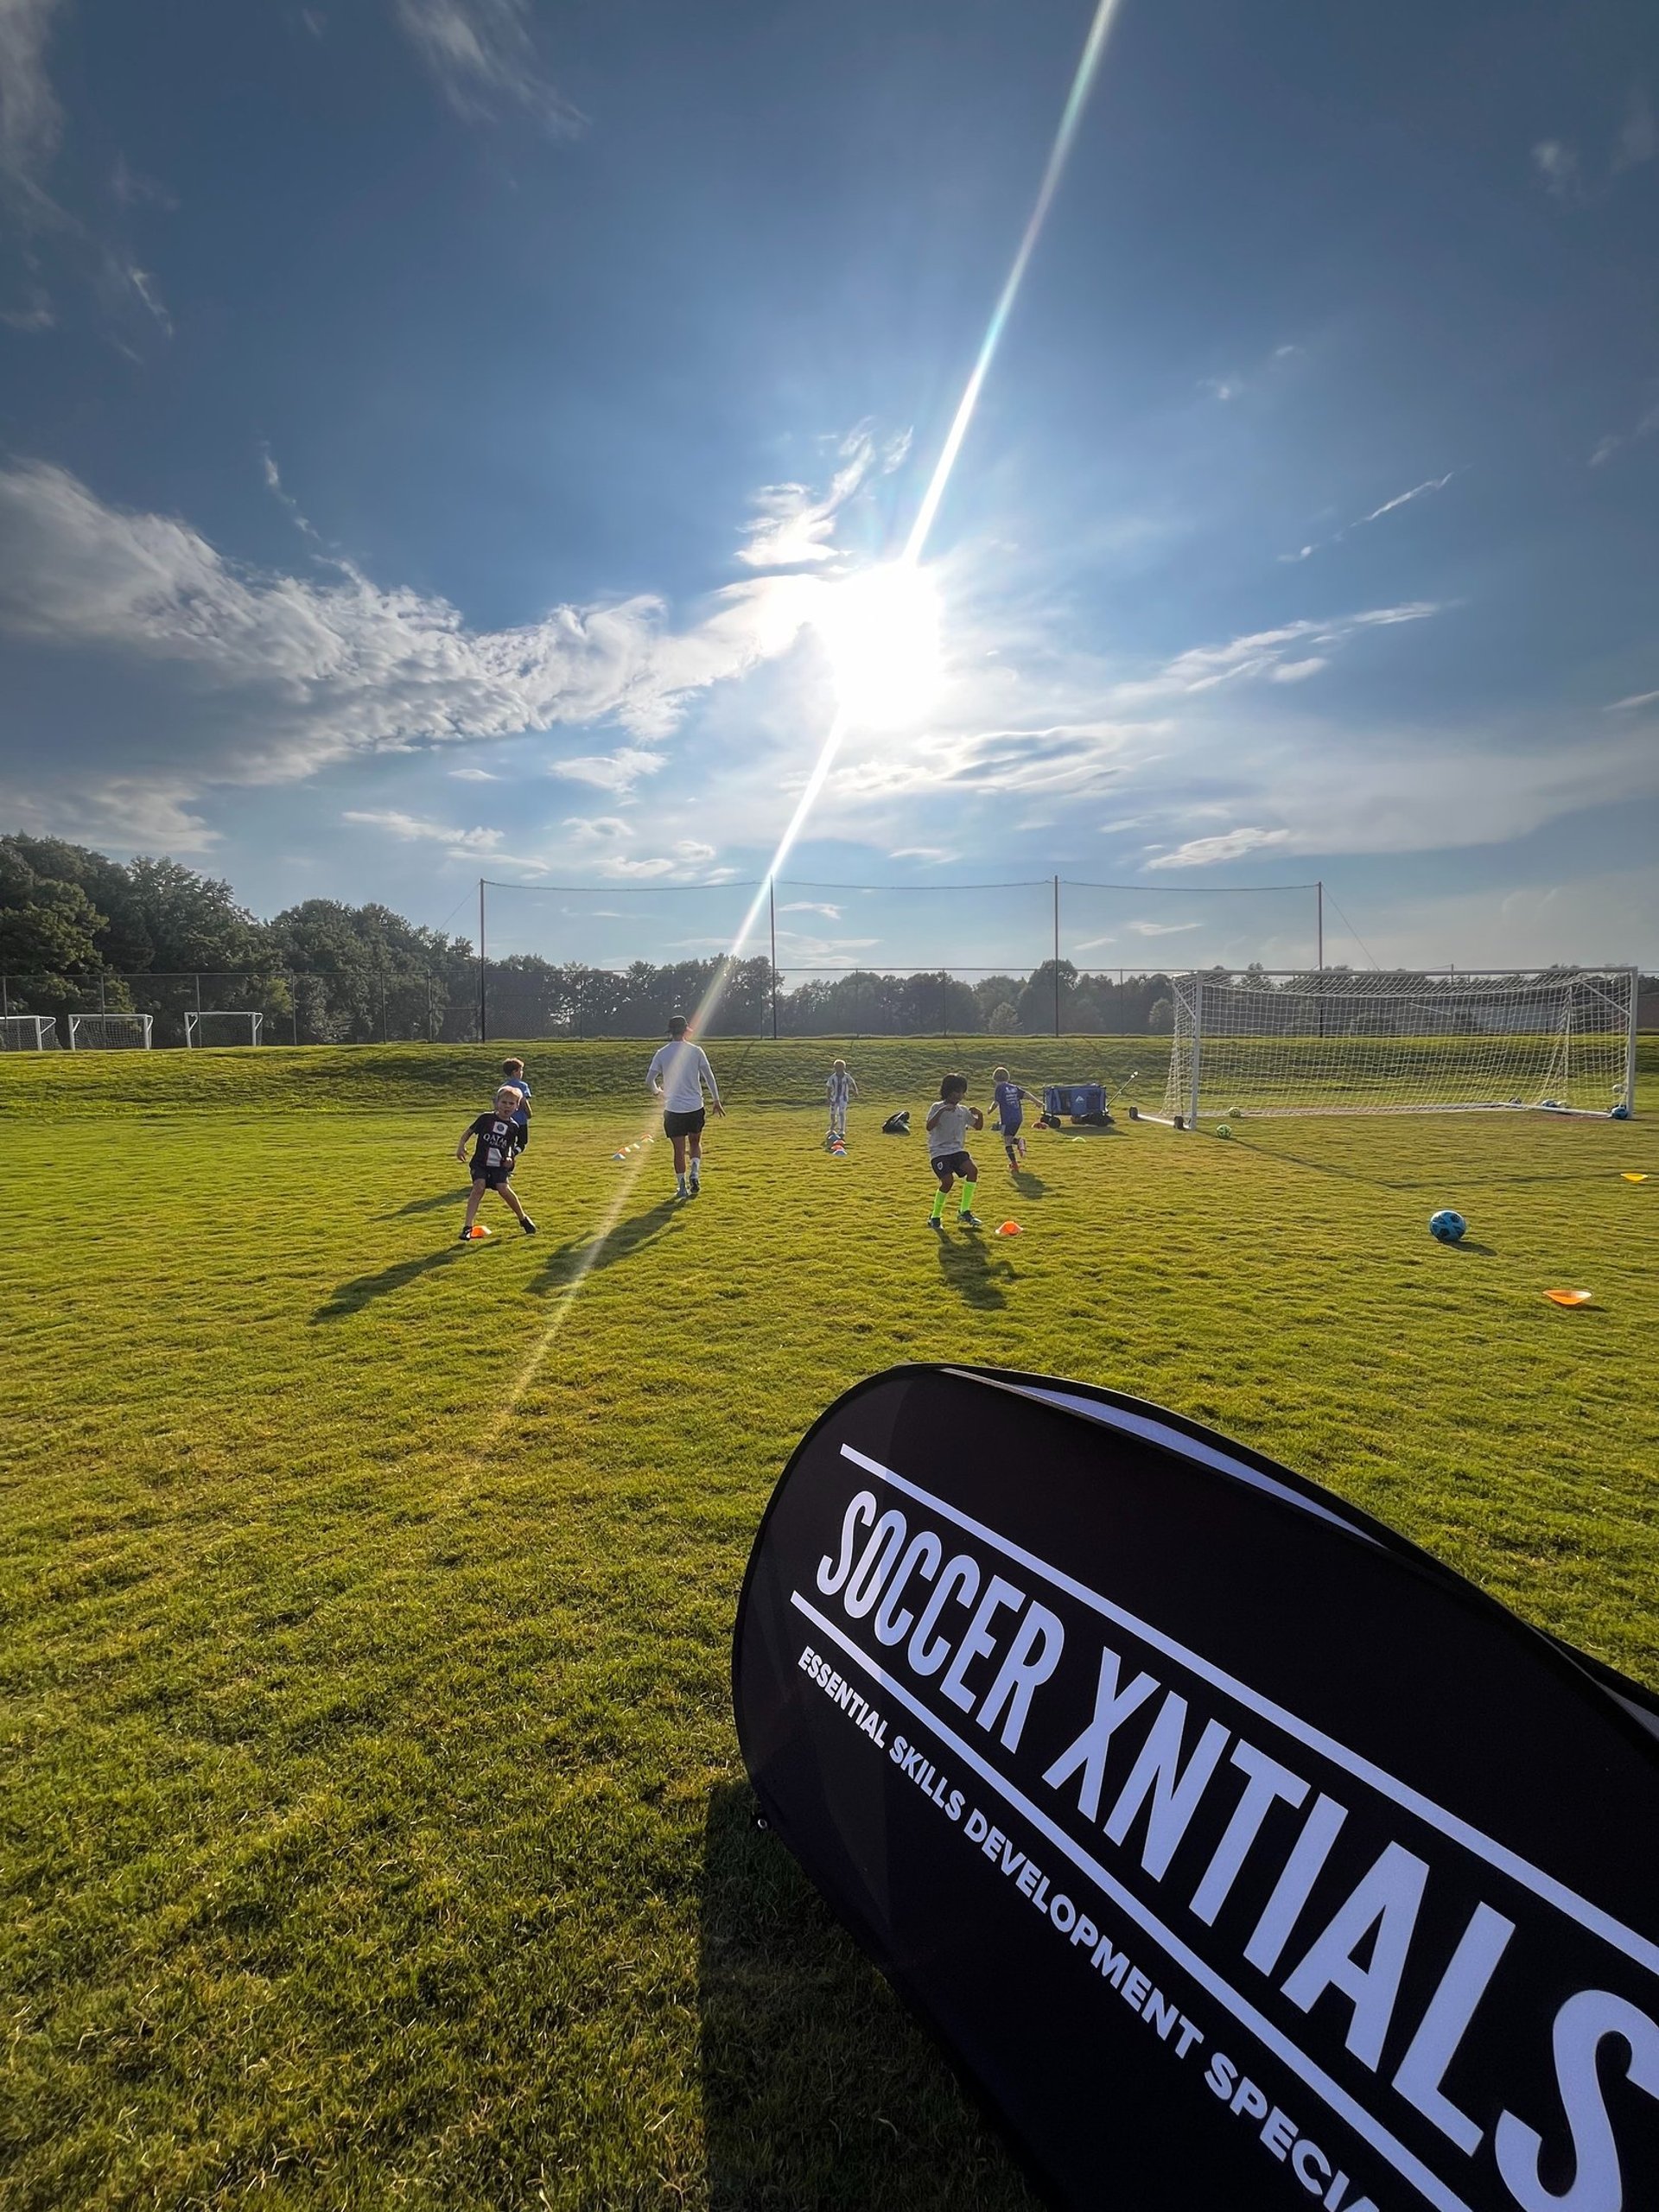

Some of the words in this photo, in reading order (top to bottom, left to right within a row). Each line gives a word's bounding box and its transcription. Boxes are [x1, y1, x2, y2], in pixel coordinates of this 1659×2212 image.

[798, 1646, 887, 1748] ESSENTIAL
[888, 1736, 965, 1821] SKILLS
[963, 1808, 1204, 2059] DEVELOPMENT
[817, 1491, 1064, 1753] SOCCER
[1042, 1647, 1659, 2212] XNTIALS
